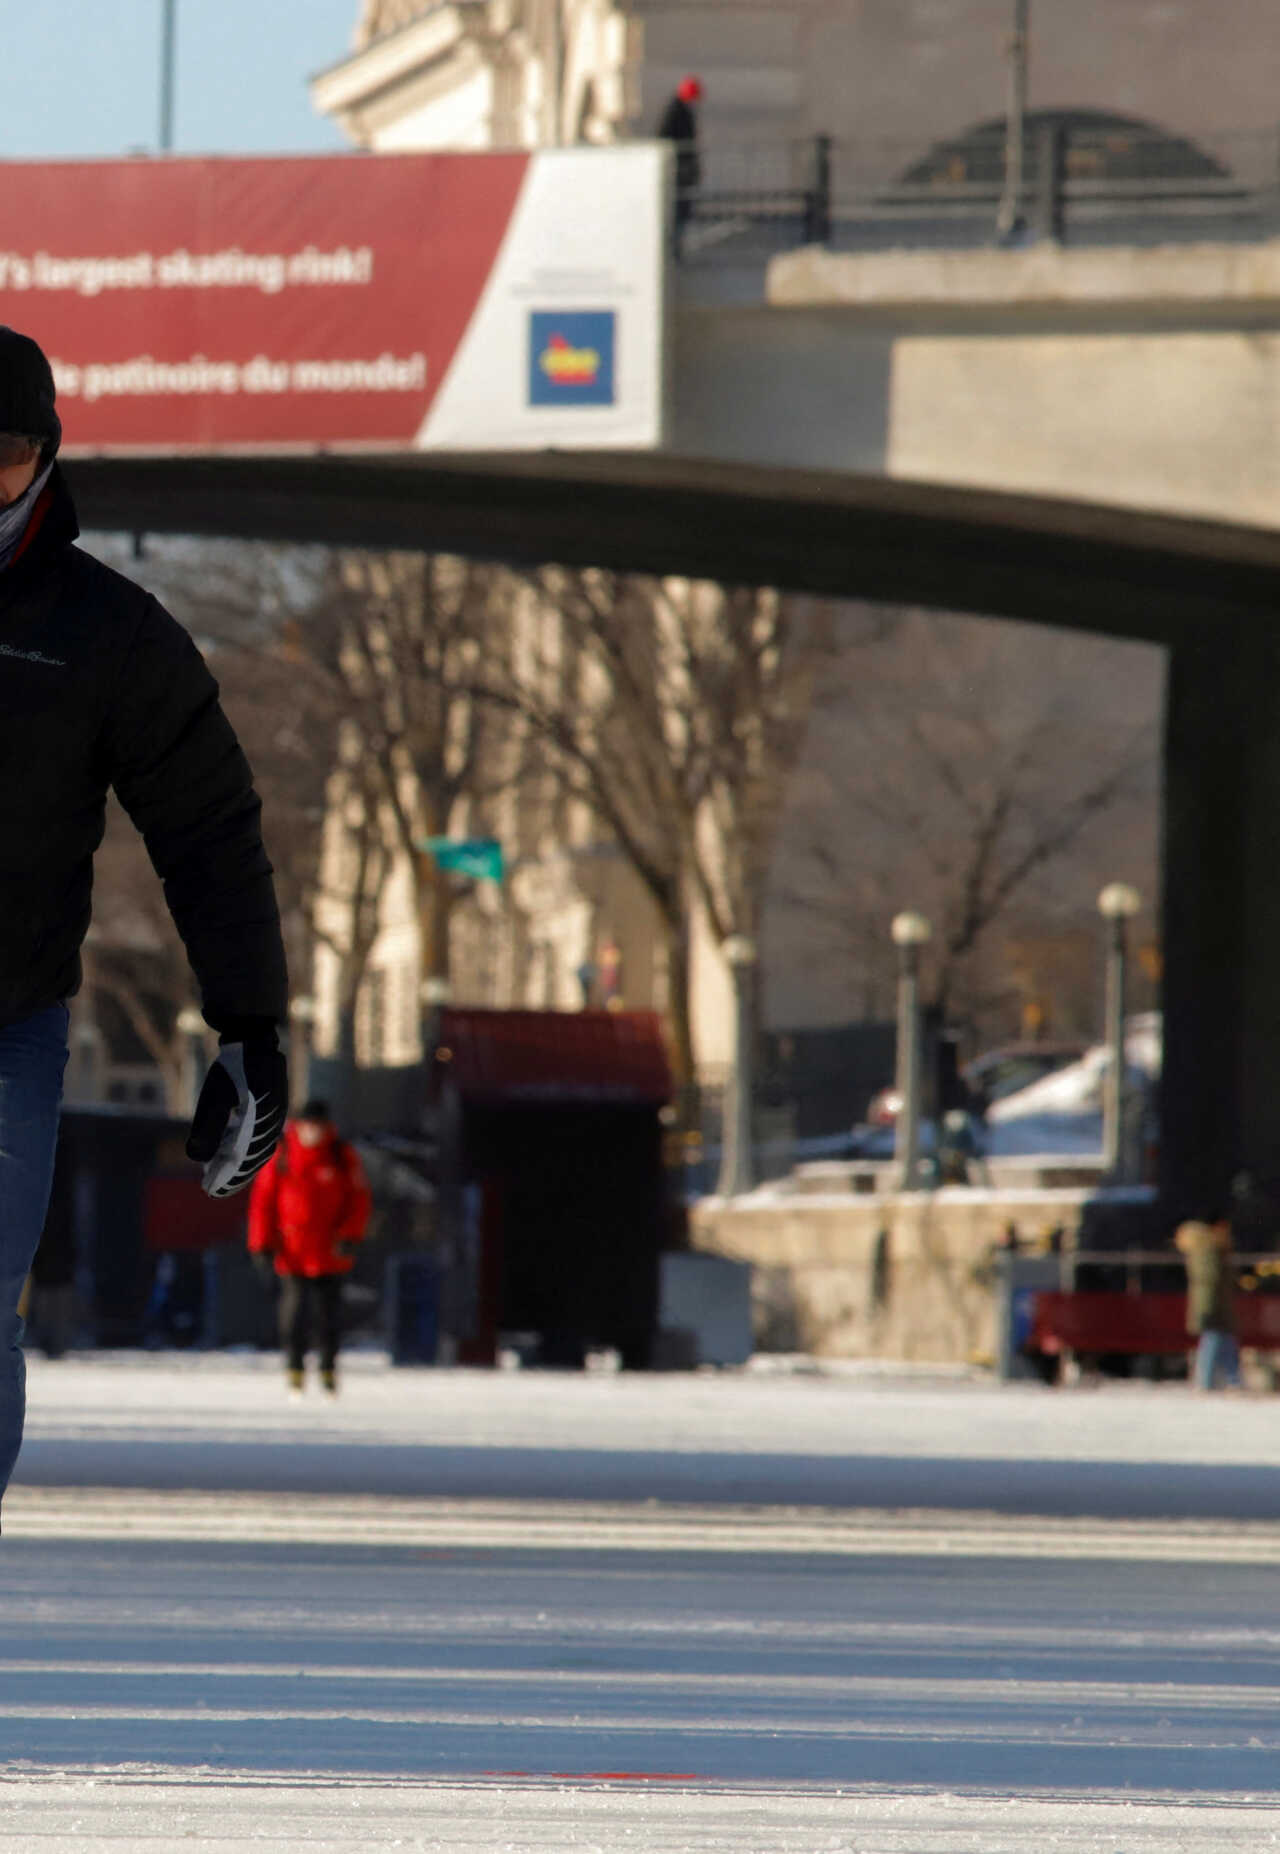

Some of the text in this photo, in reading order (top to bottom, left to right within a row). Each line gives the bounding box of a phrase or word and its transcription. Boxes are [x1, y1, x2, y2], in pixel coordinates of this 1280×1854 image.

[34, 250, 153, 295] largest
[157, 247, 285, 294] skating
[288, 245, 373, 284] rink!
[84, 353, 237, 402] patinoire
[244, 352, 289, 394] du
[295, 350, 425, 393] monde!
